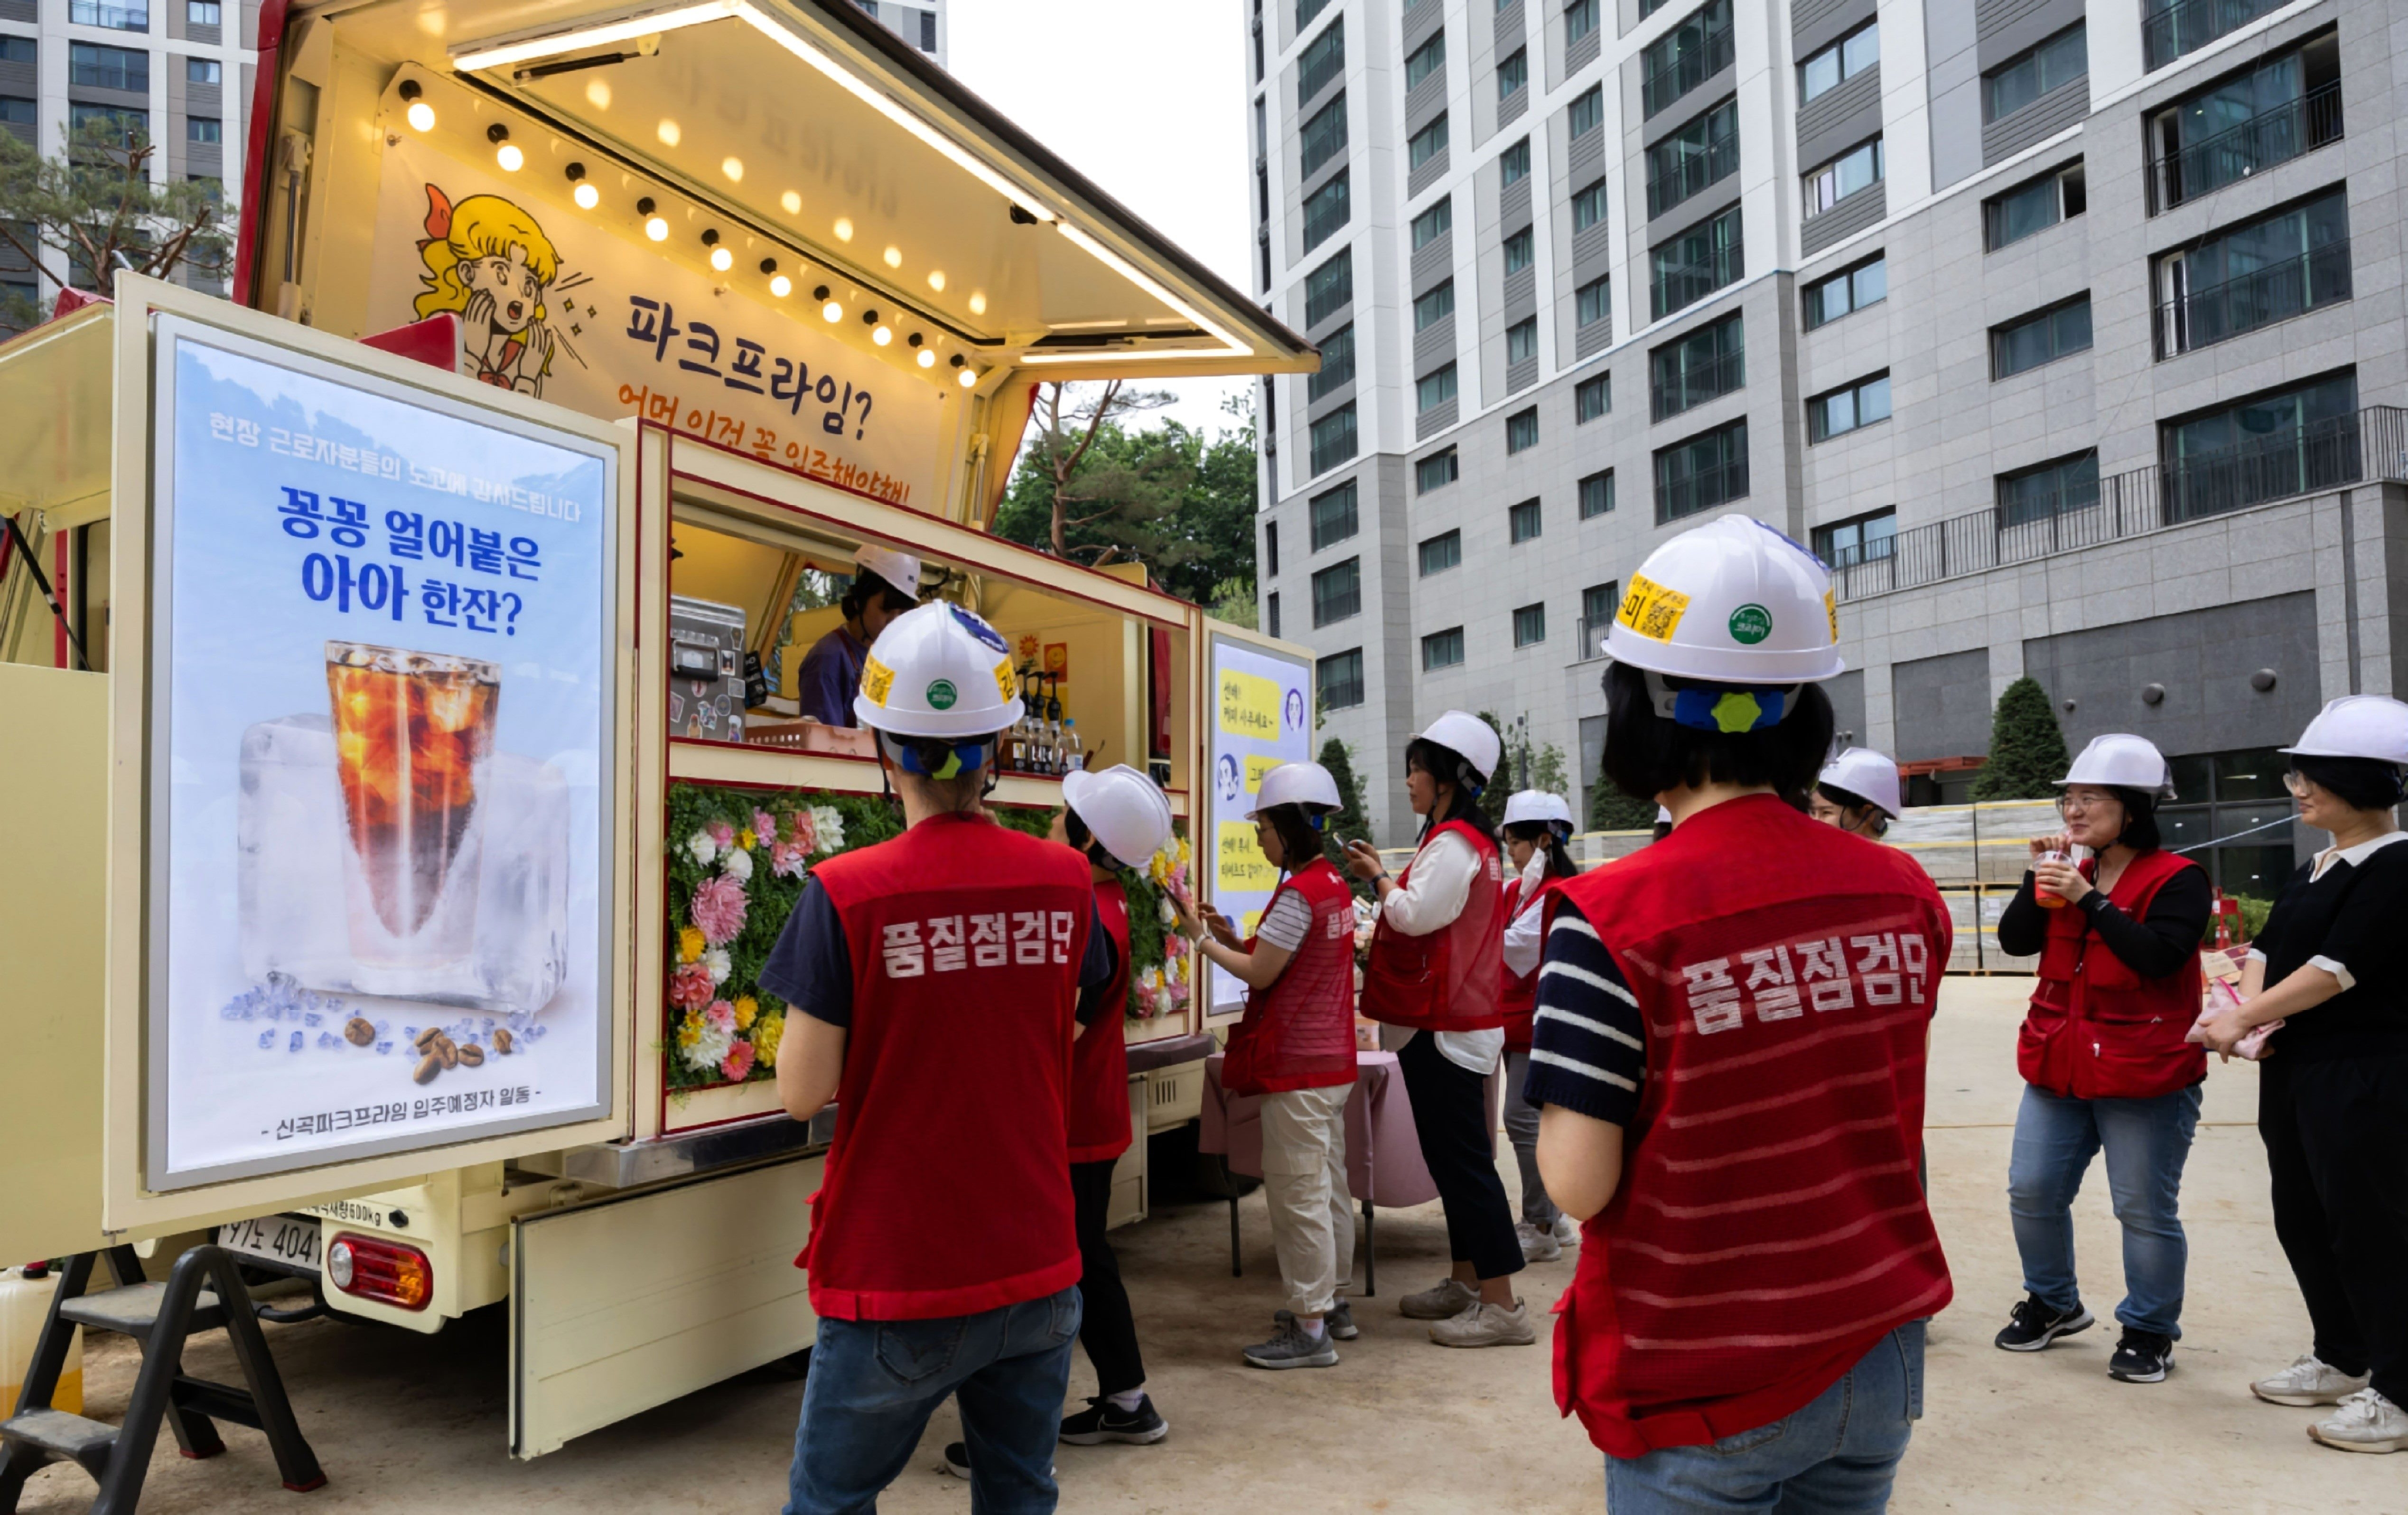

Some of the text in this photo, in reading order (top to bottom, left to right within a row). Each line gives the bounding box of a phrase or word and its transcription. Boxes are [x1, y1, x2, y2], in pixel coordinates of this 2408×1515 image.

[618, 383, 679, 428] 어머
[626, 295, 872, 440] 파크프라임?
[210, 411, 581, 524] 현장 근로자분들의 노고에 감사드립니다
[277, 485, 541, 581] 꽁꽁 얼어붙은
[301, 552, 523, 636] 아아 한잔?
[882, 910, 1074, 979] 품질점검단
[1681, 932, 1928, 1036] 품질점검단
[276, 1101, 407, 1141] 신곡파크프라임
[413, 1089, 495, 1119] 입주예정자
[500, 1085, 530, 1106] 일동
